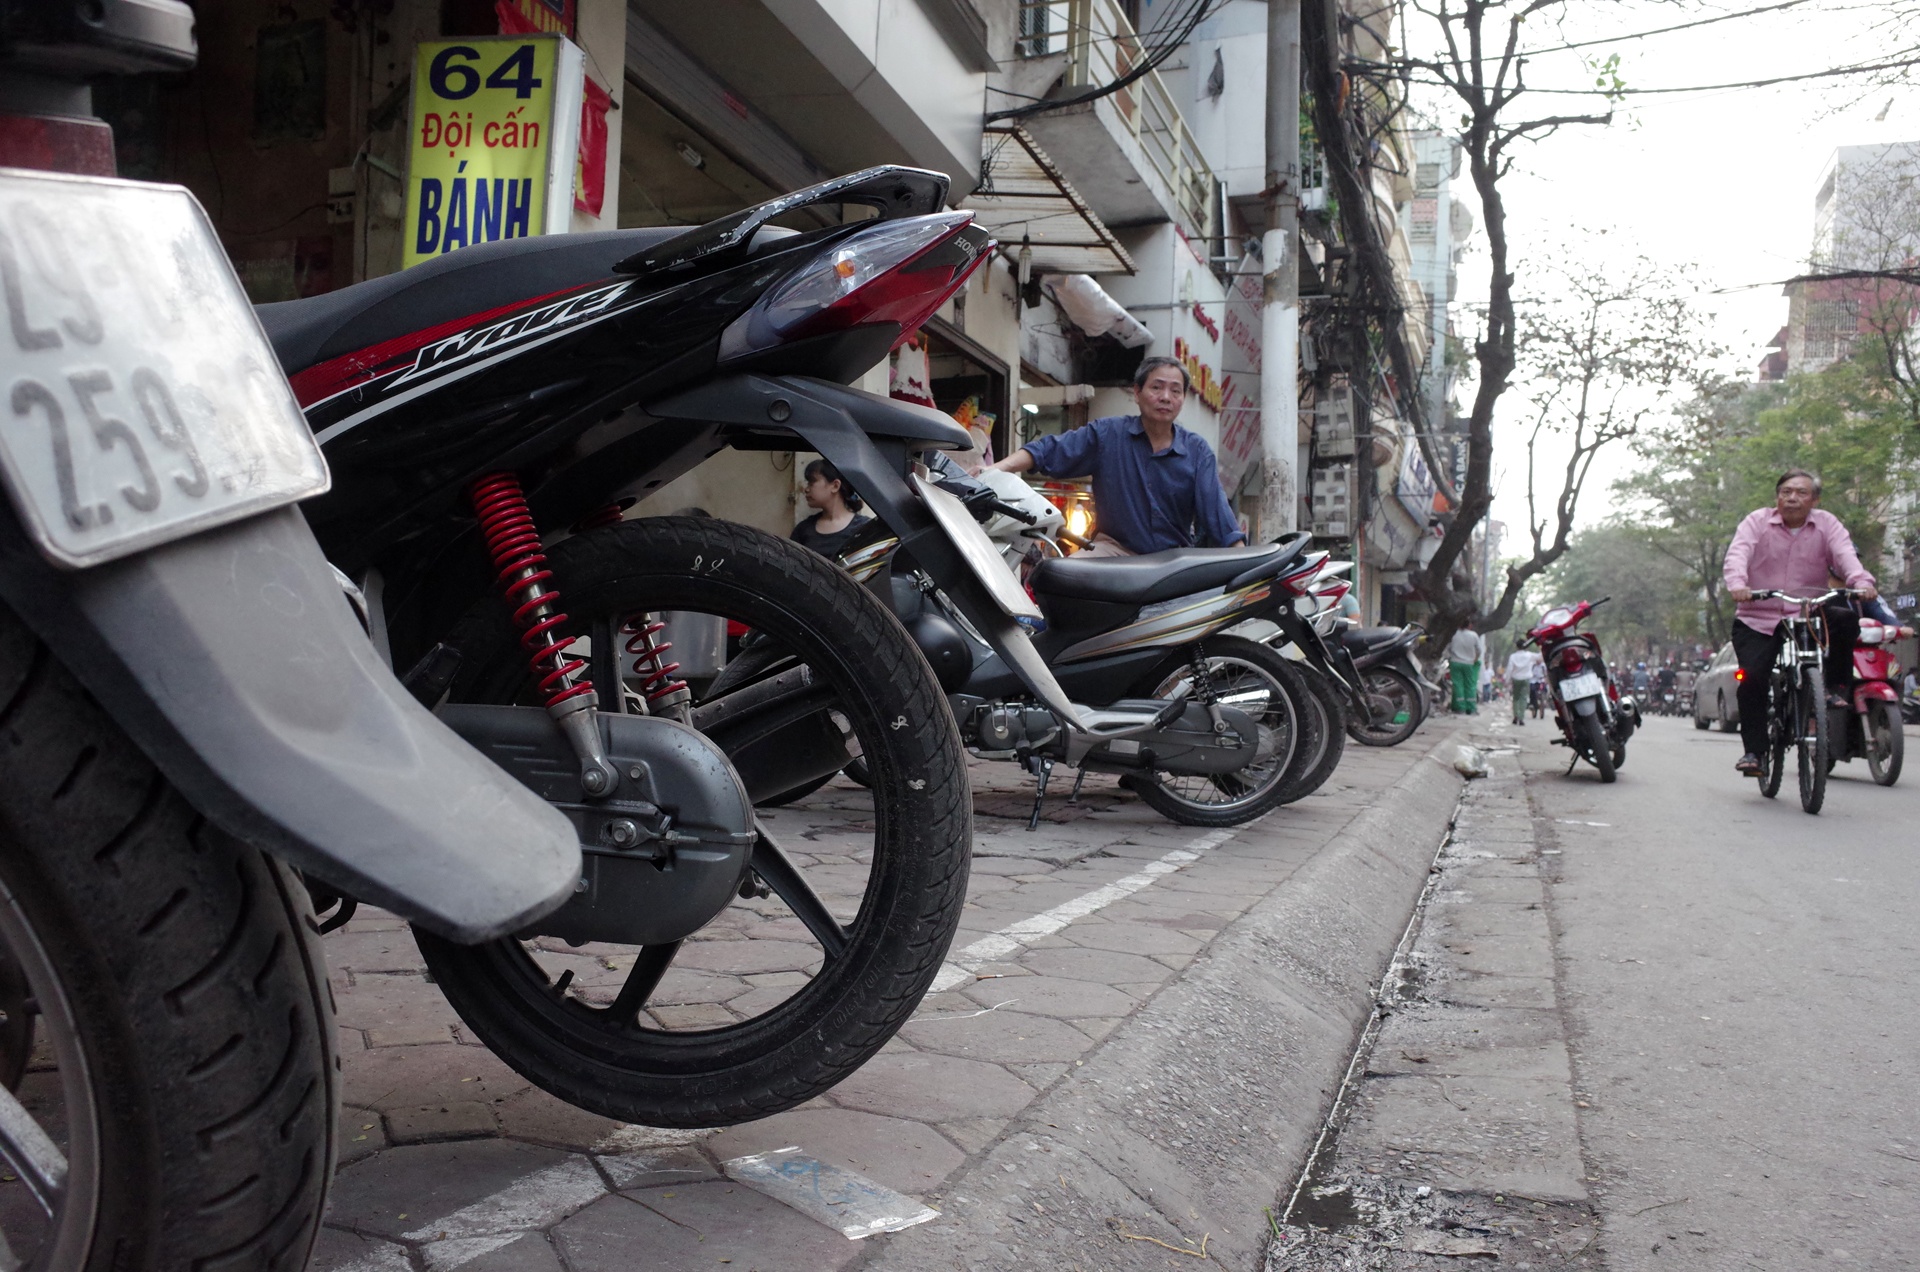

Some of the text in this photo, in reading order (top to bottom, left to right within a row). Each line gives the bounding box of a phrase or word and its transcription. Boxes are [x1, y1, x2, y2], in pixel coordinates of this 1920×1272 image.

[429, 45, 542, 100] 64
[421, 106, 540, 158] Đội cấn
[416, 160, 532, 254] BÁNH
